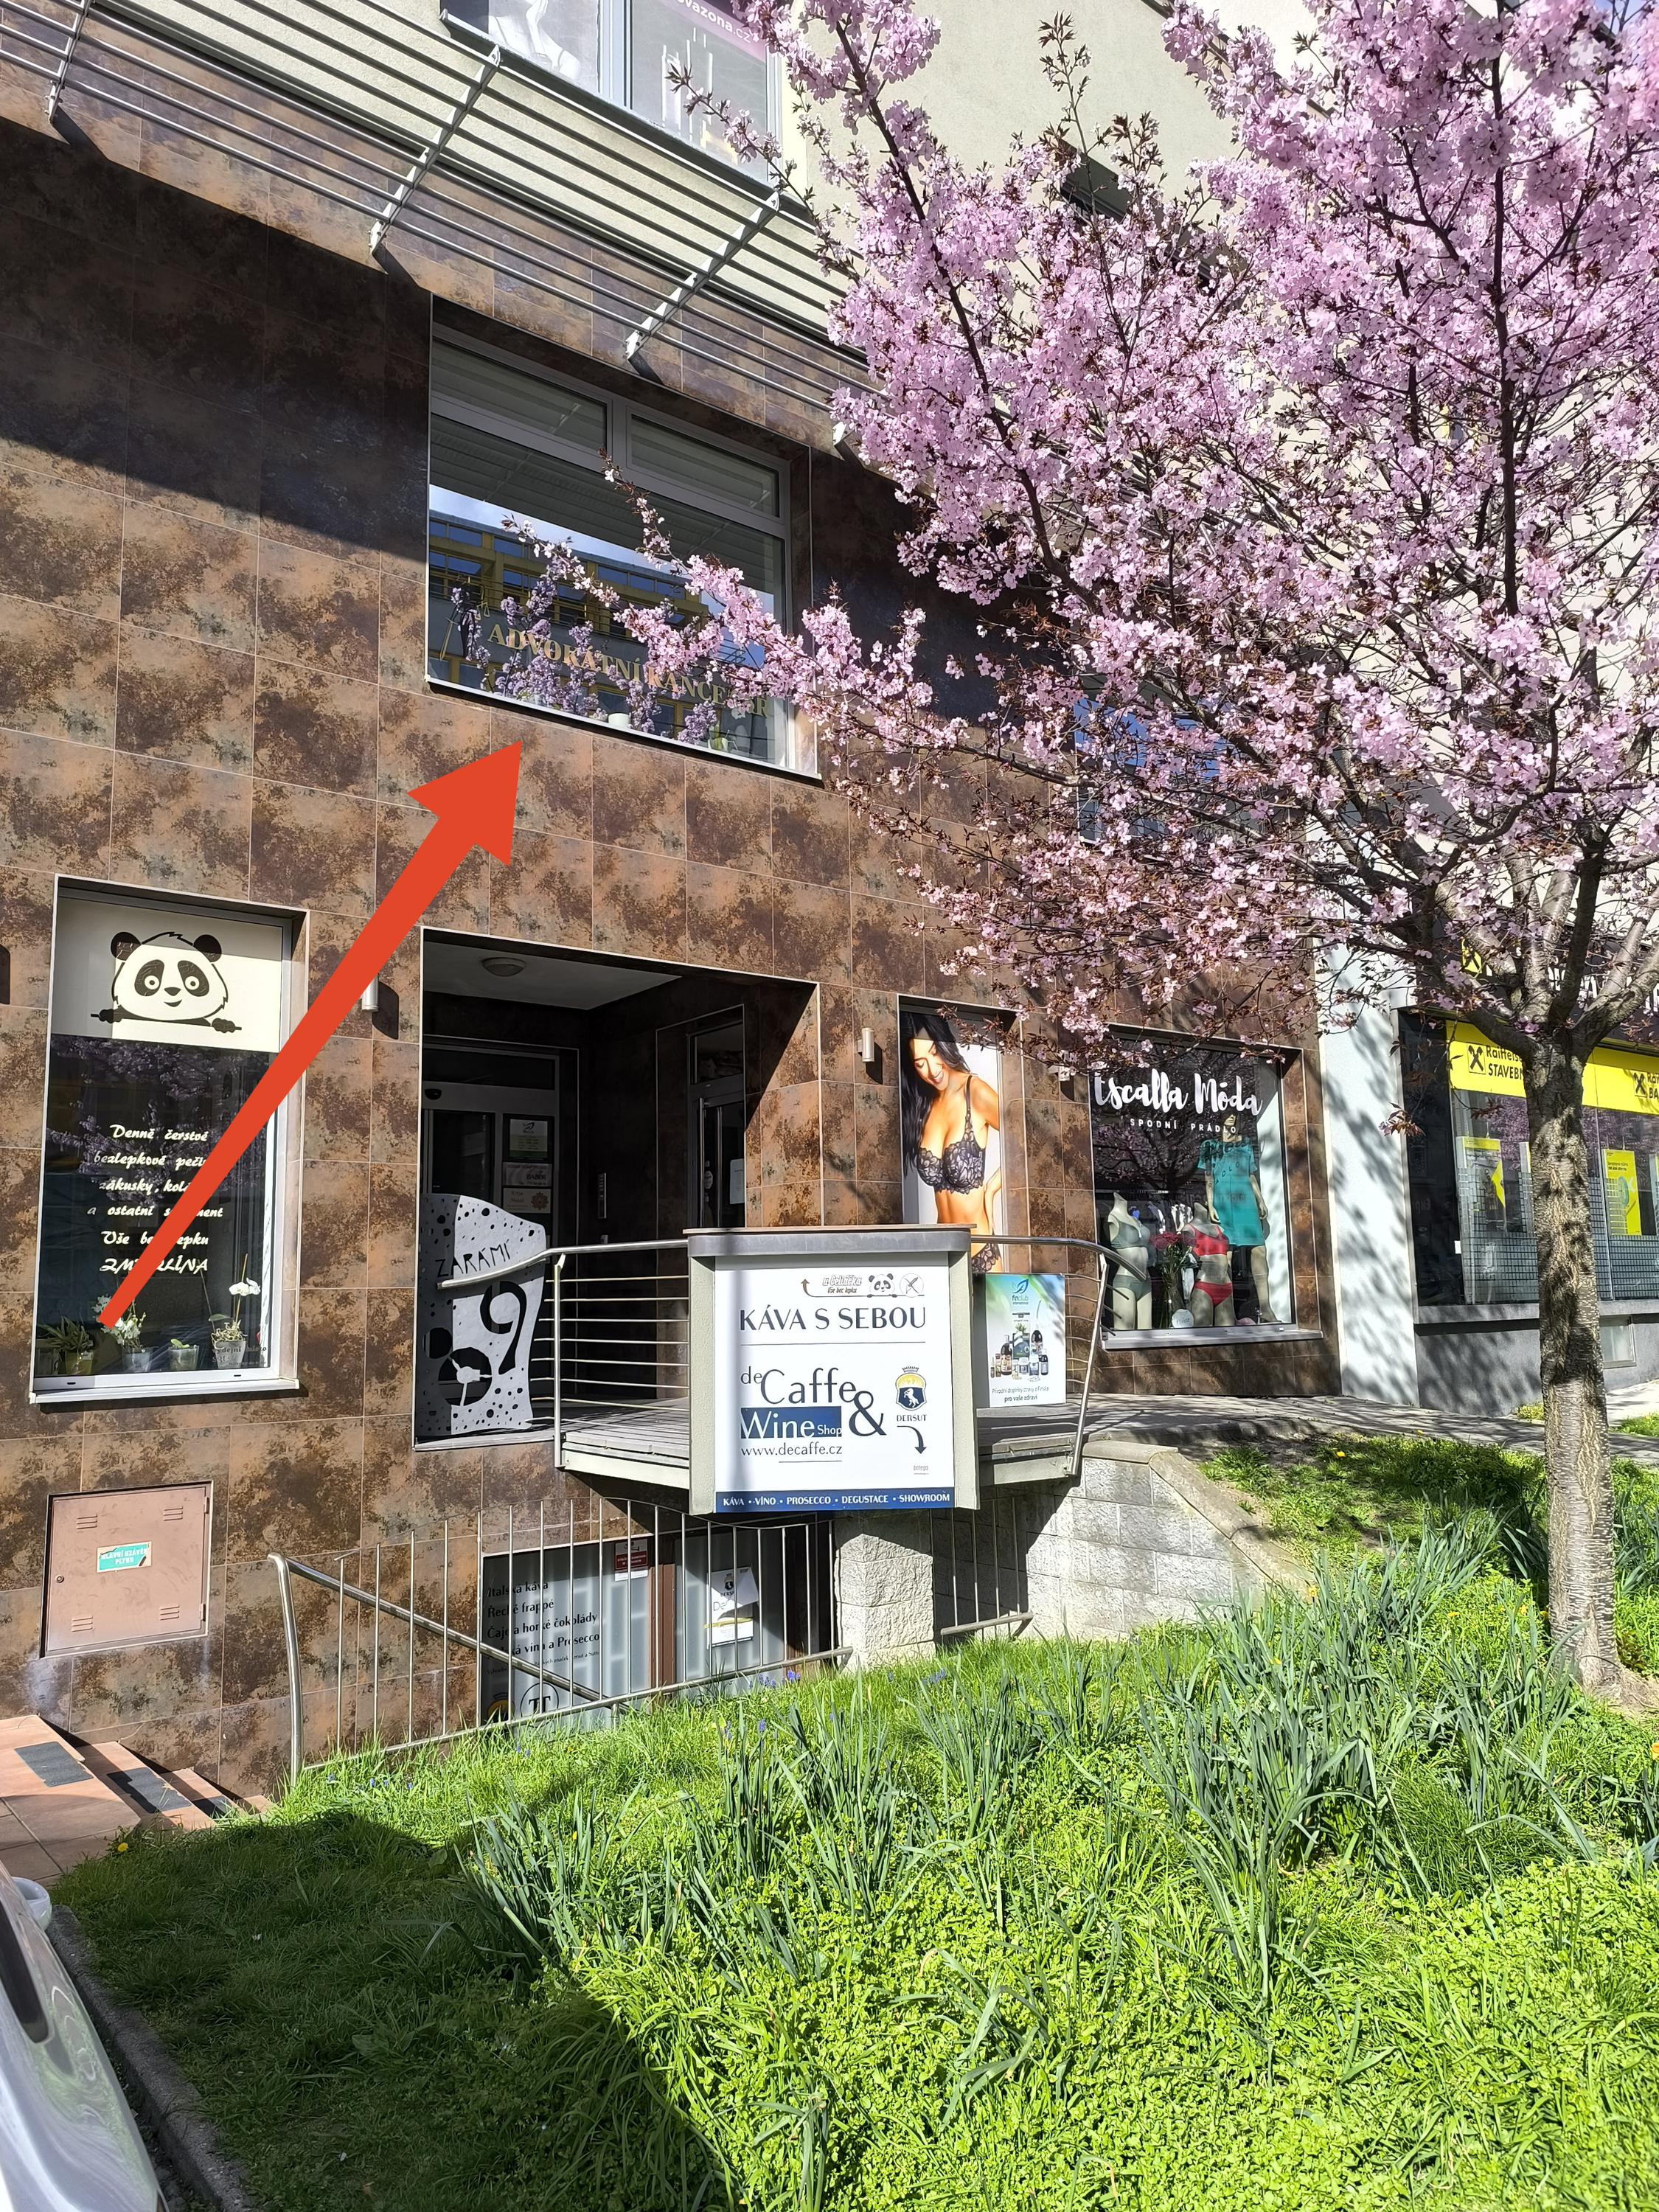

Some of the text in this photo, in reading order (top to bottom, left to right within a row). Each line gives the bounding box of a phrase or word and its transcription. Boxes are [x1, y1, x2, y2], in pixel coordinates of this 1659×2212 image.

[487, 623, 641, 681] ADVOKÁTNÍ
[109, 1124, 209, 1141] Denně čerstvé
[1130, 1118, 1237, 1133] SPODNÍ PRÁDLO
[94, 1150, 167, 1169] bezlepkové
[87, 1206, 97, 1215] a
[107, 1205, 155, 1217] ostatní
[100, 1231, 130, 1245] Vše
[740, 1304, 926, 1331] KÁVA S SEBOU
[849, 1391, 887, 1437] &
[740, 1410, 843, 1439] Wine Shop
[741, 1441, 843, 1456] www.decaffe.cz
[723, 1494, 950, 1506] KÁVA VÍNO PROSECCO DEGUSTACE SHOWROOM
[513, 1627, 520, 1635] a
[549, 1641, 554, 1649] a
